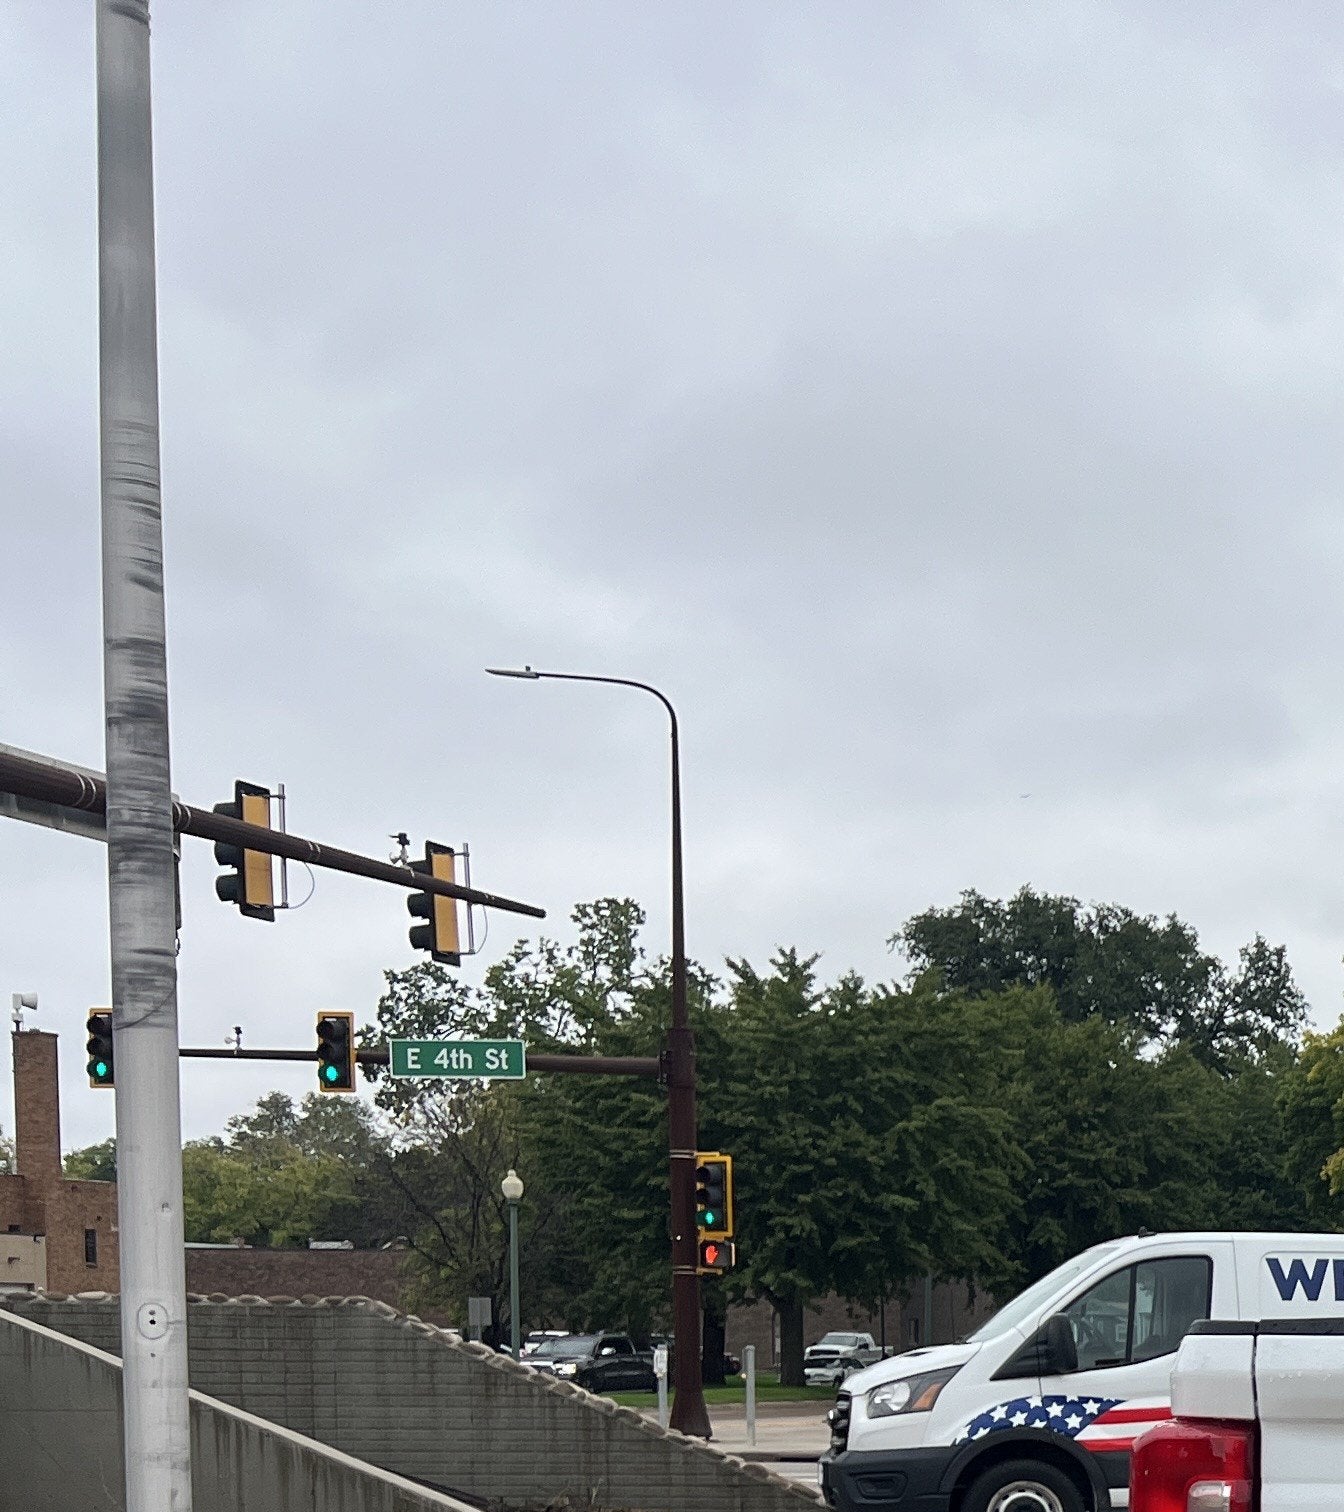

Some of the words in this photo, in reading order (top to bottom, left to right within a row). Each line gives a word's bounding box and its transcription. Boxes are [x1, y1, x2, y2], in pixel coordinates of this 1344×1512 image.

[407, 1048, 421, 1069] E
[434, 1048, 473, 1069] 4th
[485, 1048, 509, 1070] St
